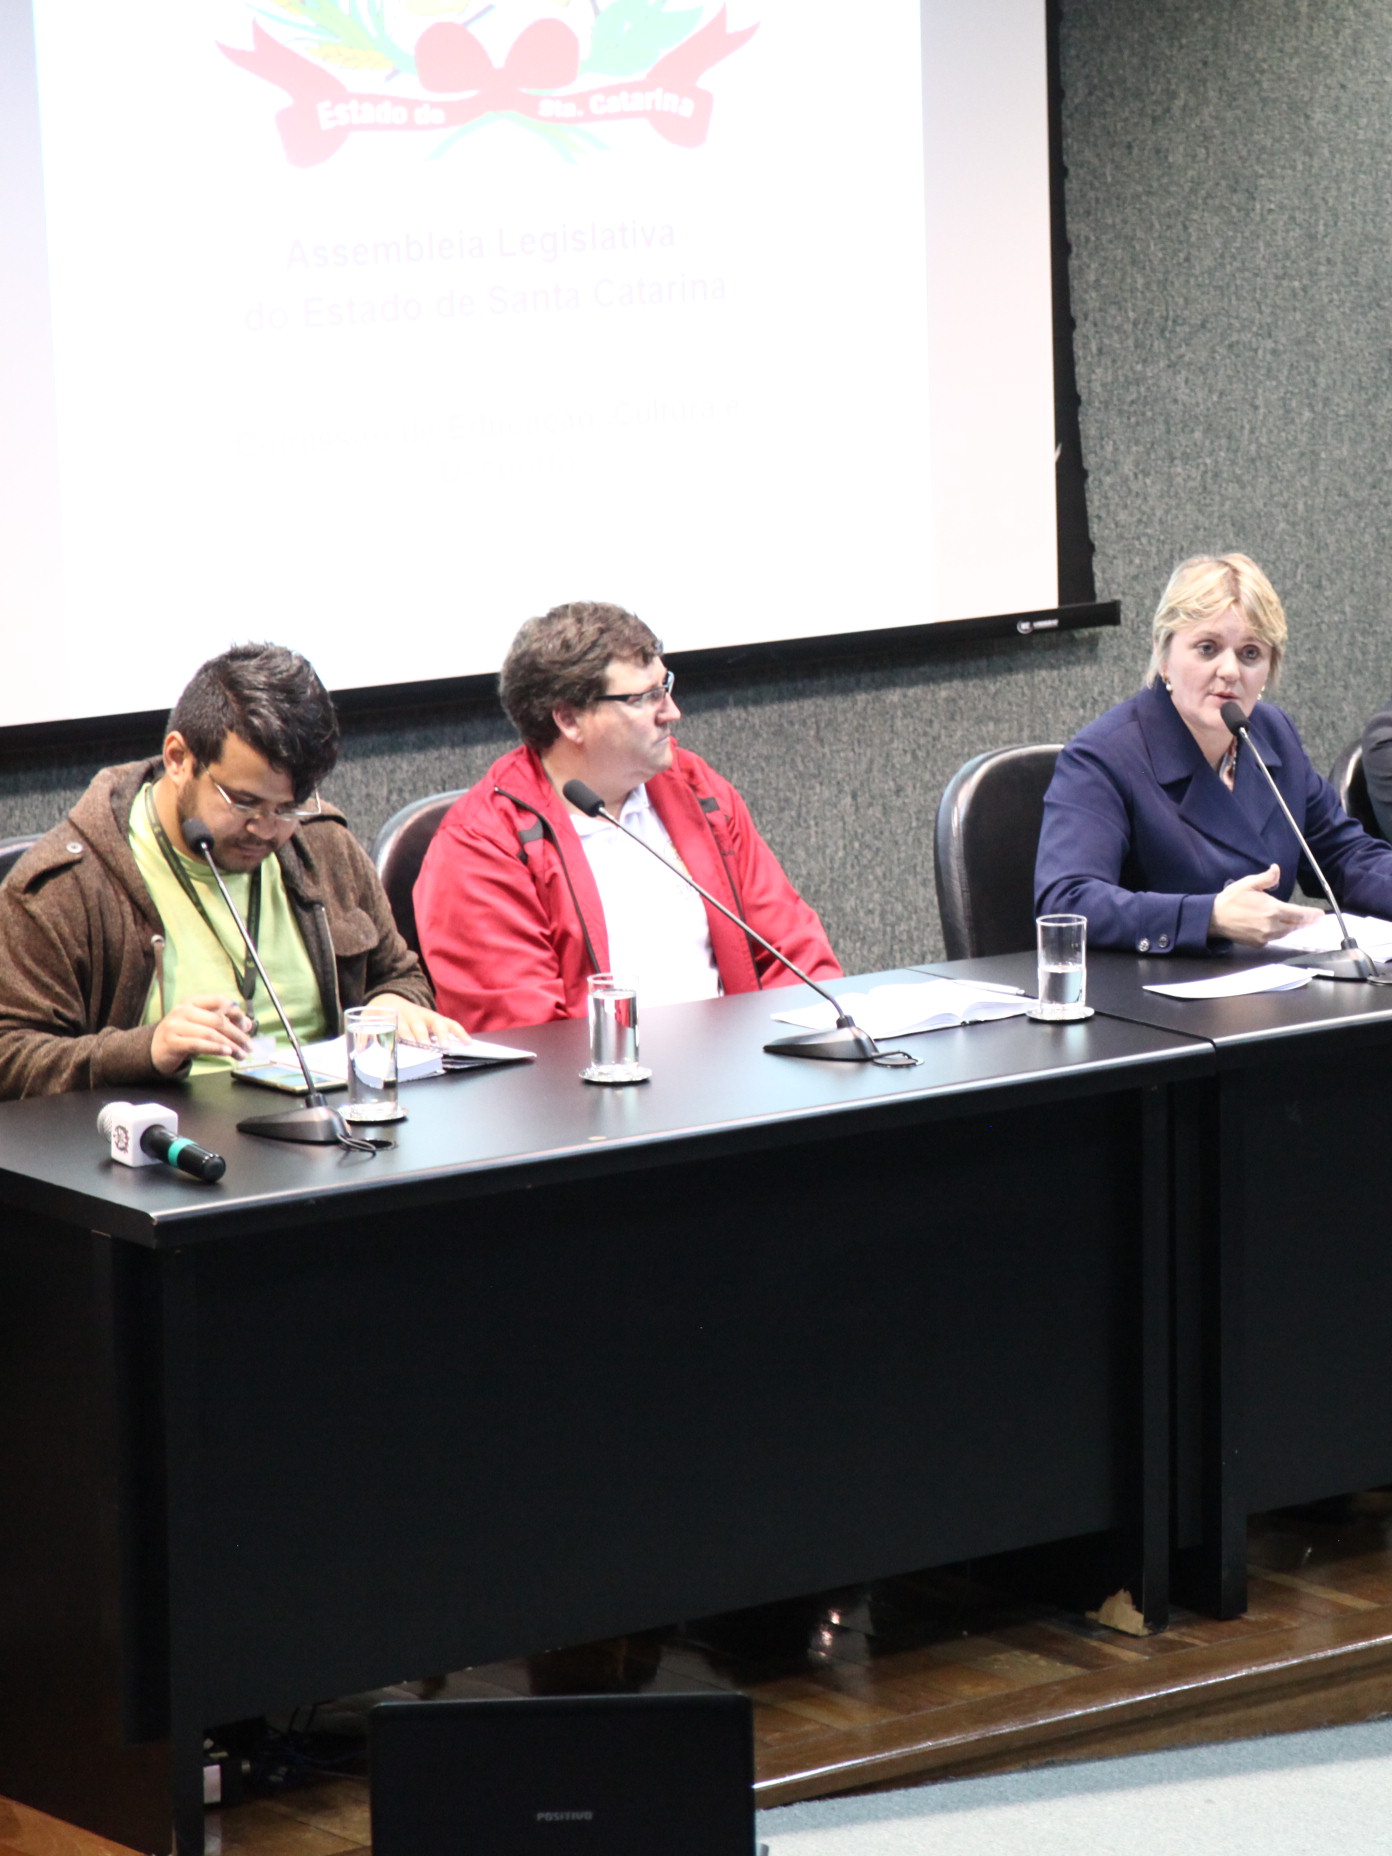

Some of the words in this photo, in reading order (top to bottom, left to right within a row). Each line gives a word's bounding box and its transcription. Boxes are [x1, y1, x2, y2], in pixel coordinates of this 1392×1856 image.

[316, 99, 408, 131] Estado
[588, 87, 695, 118] Catarina
[286, 231, 485, 271] Assembleia
[497, 219, 677, 262] Legislativa
[244, 302, 289, 331] do
[303, 293, 422, 328] Estado
[435, 289, 476, 318] de
[488, 283, 581, 315] Santa
[593, 274, 728, 309] Catarina
[536, 1811, 594, 1821] POSITIVO
